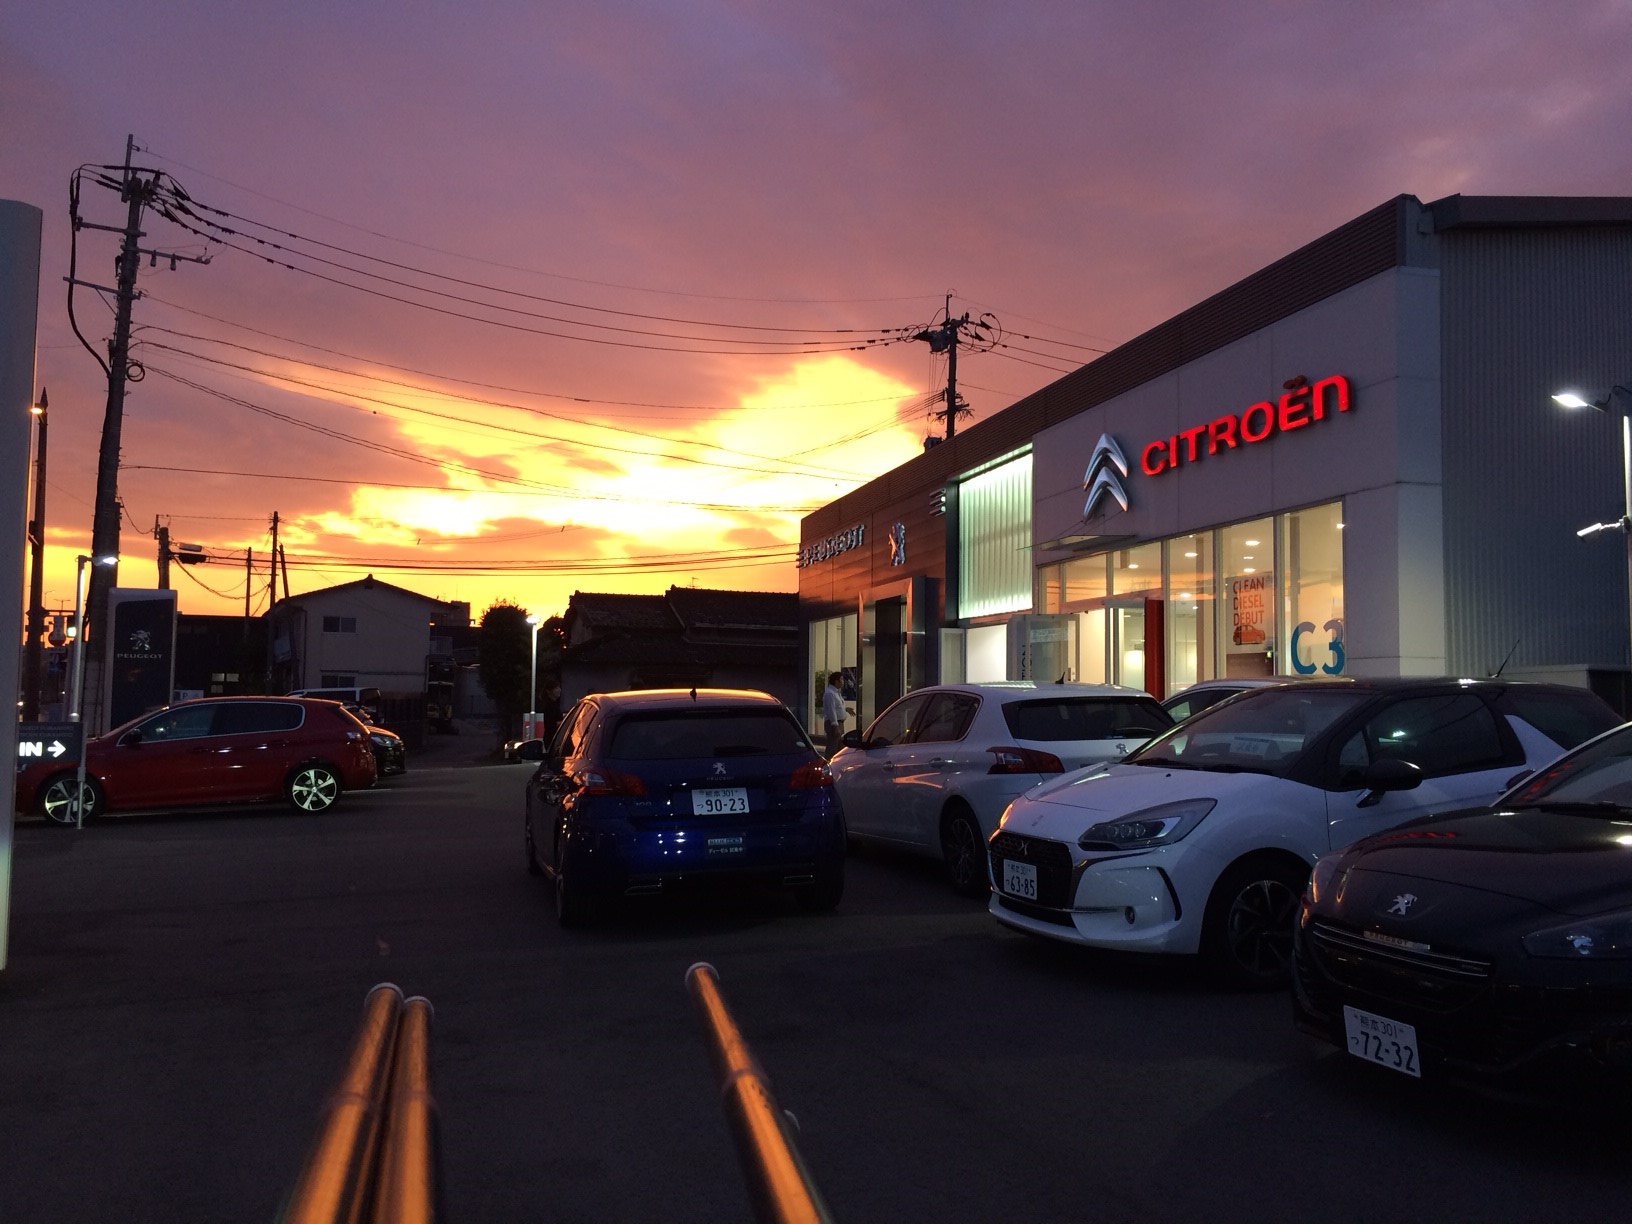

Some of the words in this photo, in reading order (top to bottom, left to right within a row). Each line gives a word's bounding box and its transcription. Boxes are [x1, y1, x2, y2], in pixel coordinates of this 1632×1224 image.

[1140, 374, 1349, 476] CITROËN
[1233, 577, 1264, 594] CLEAN
[1233, 594, 1264, 610] DIESEL
[1291, 619, 1345, 675] C3
[19, 741, 43, 757] IN
[705, 798, 745, 812] 90-23
[1361, 1031, 1416, 1072] 72-32
